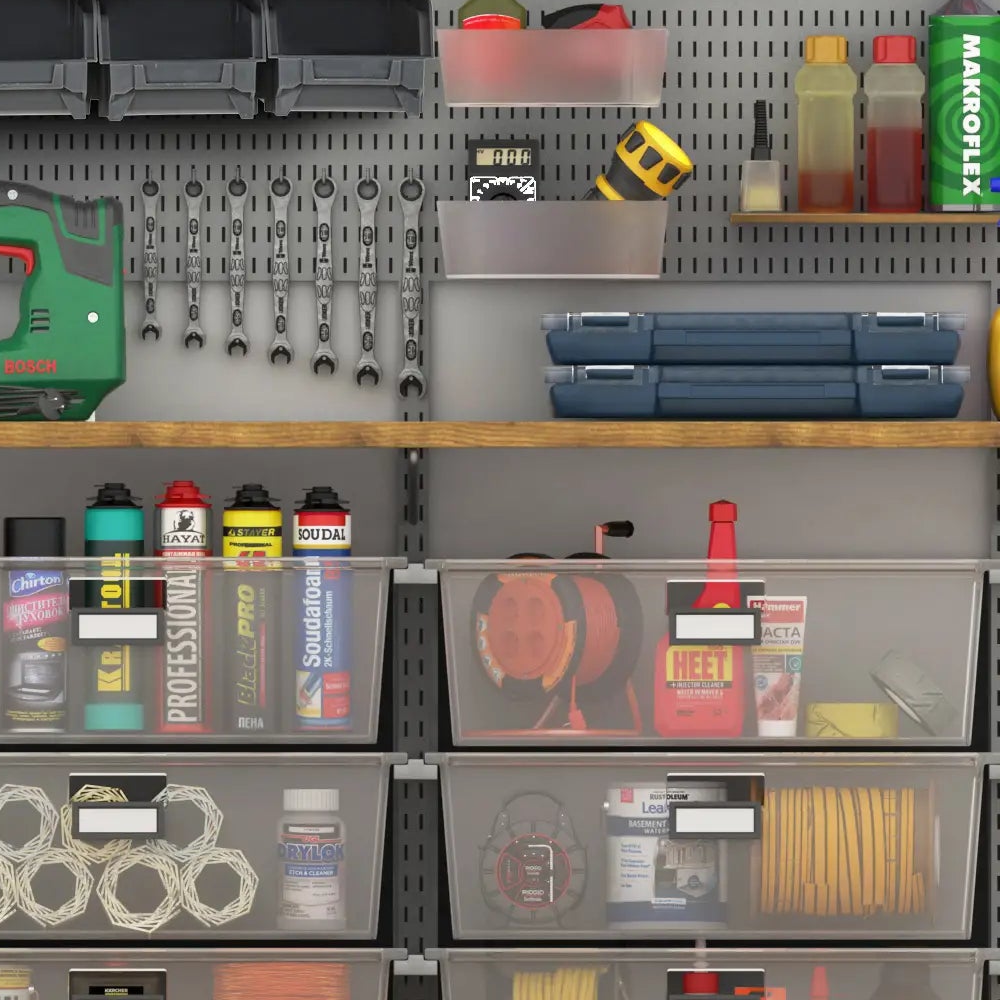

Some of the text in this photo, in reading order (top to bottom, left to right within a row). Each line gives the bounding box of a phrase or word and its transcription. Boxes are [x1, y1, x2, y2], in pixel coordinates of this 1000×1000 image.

[962, 34, 981, 196] MAKROFLEX
[4, 360, 56, 374] BOSCH
[237, 528, 276, 536] STAYER
[298, 528, 346, 540] SOUDAL
[163, 534, 205, 544] HAYAT
[12, 576, 60, 593] Chirton
[761, 627, 800, 638] АСТА
[166, 559, 198, 722] PROFESSIONAL
[673, 650, 728, 680] HEET
[238, 716, 264, 729] ПЕНА
[628, 820, 666, 828] BASEMENT
